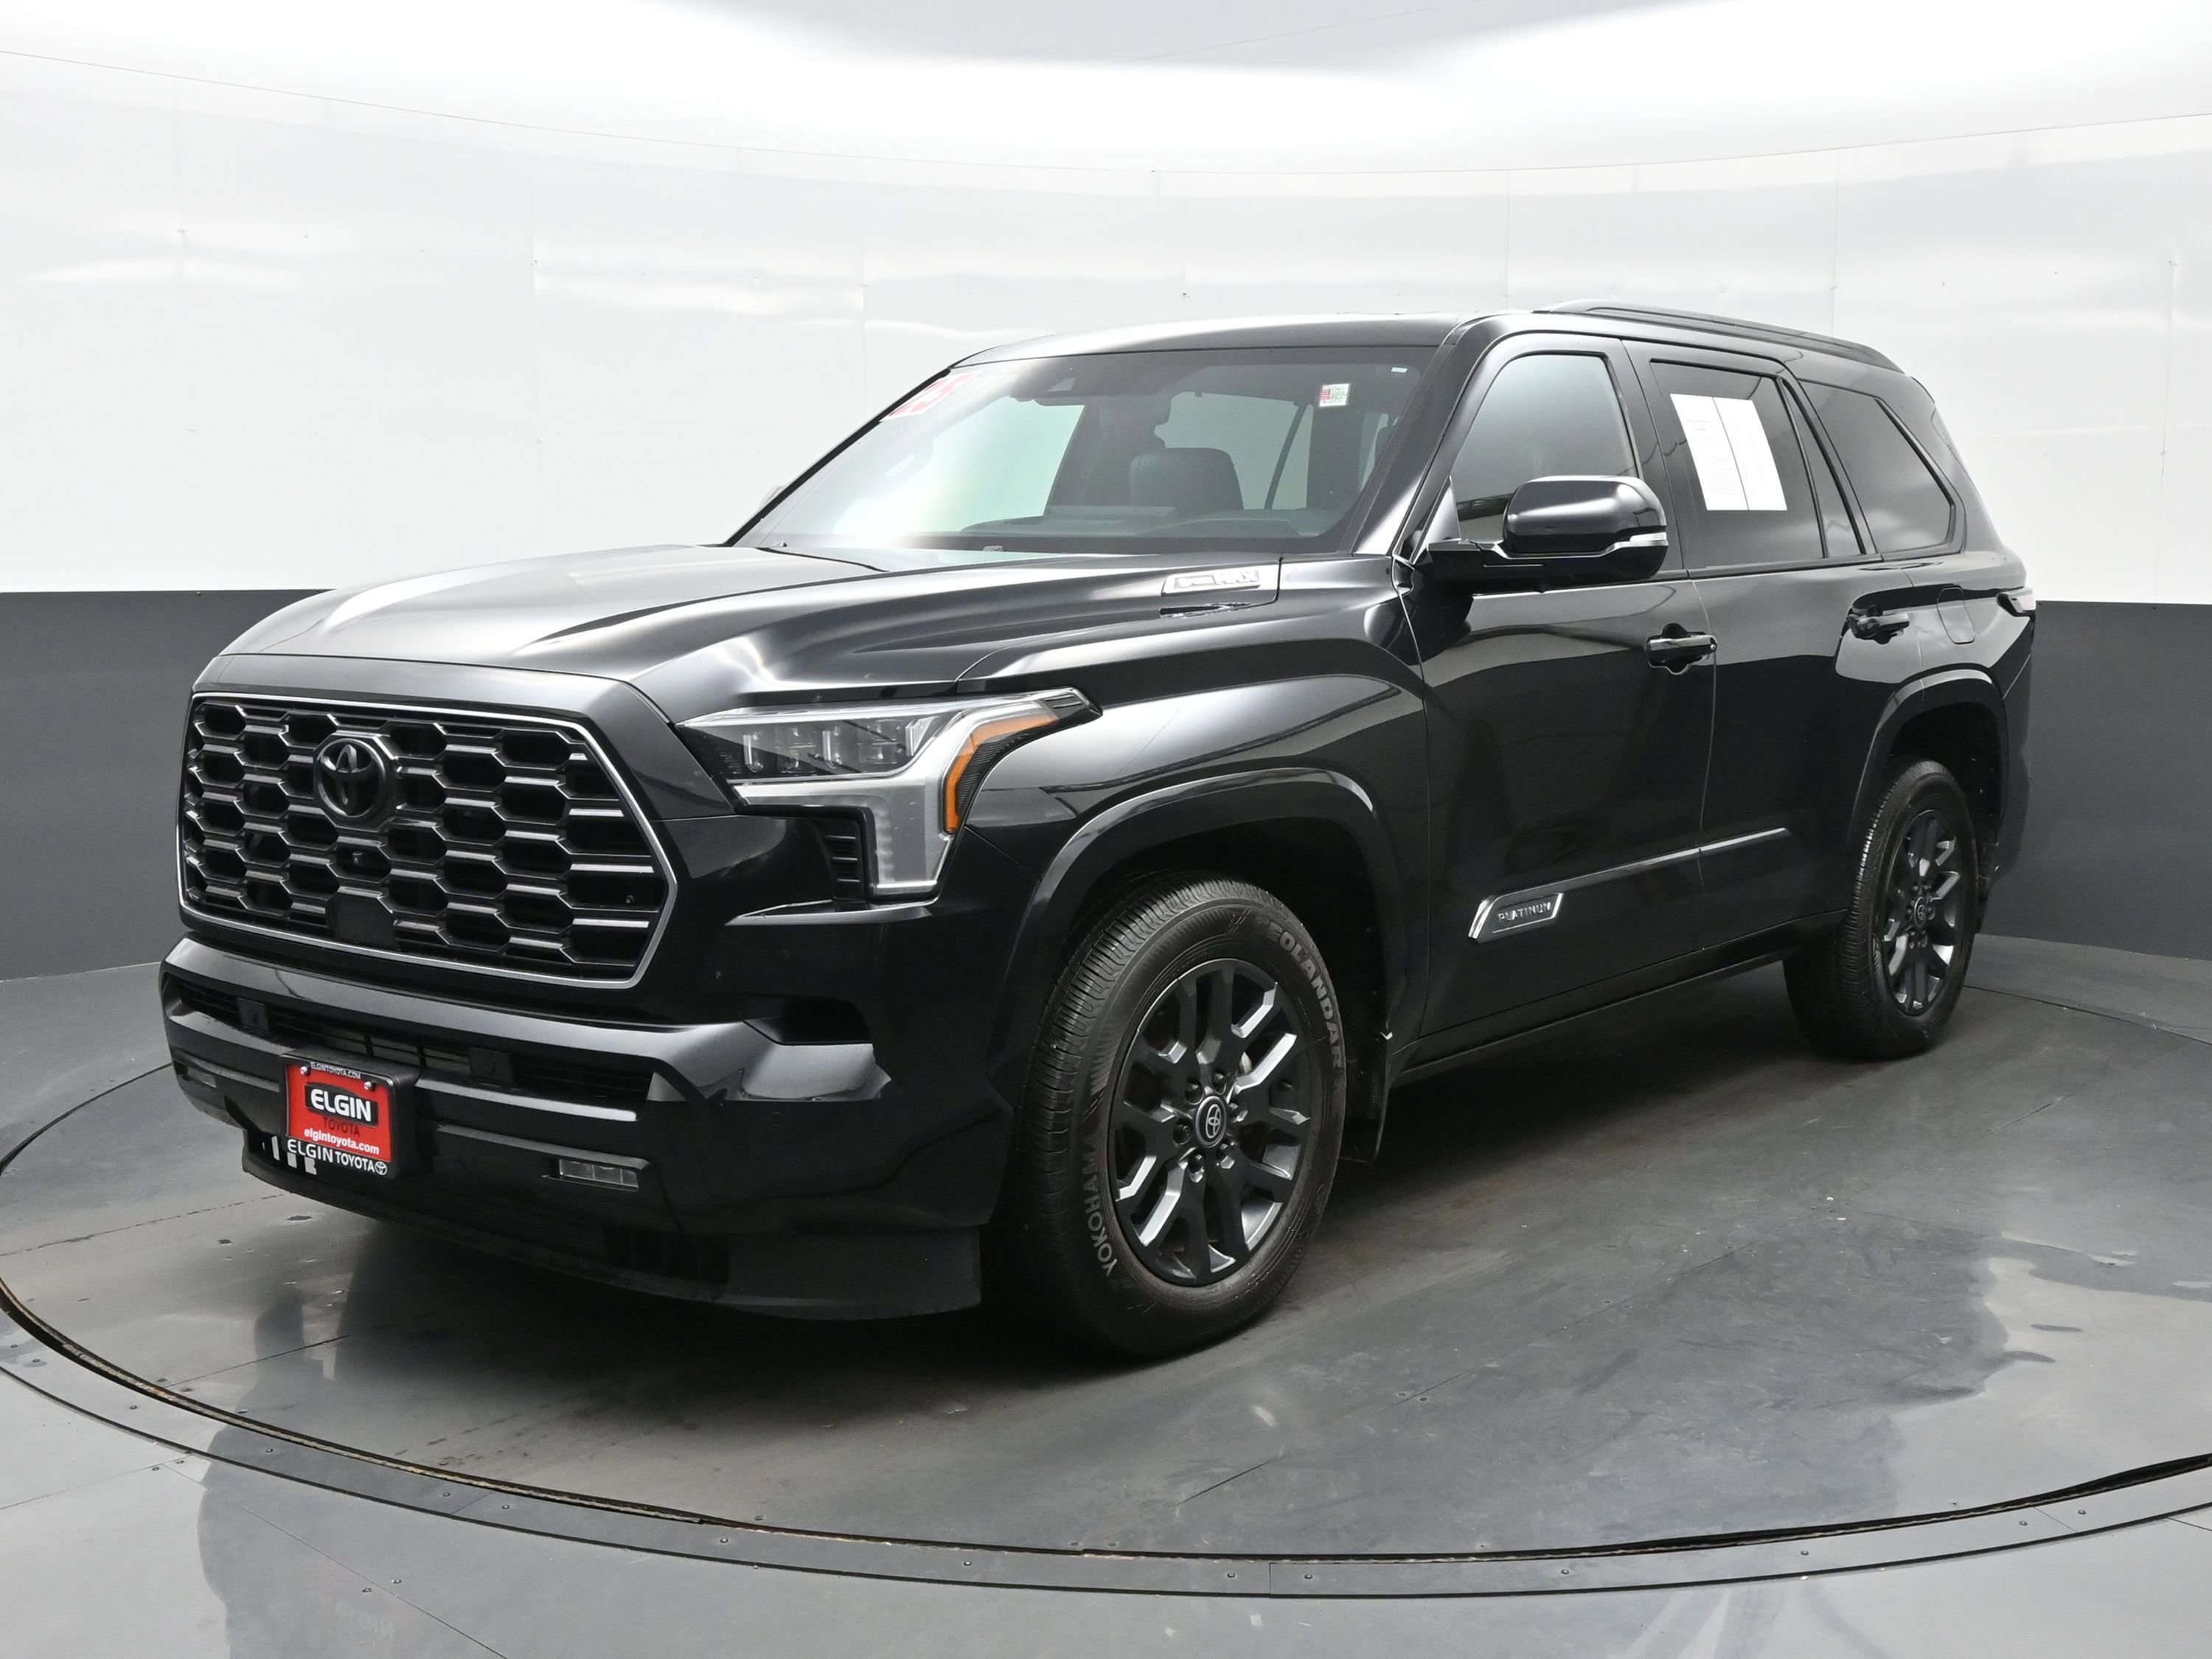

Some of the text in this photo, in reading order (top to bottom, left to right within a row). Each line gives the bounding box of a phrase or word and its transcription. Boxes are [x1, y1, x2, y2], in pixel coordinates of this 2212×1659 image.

[1498, 902, 1551, 922] PLATINUM
[1256, 916, 1343, 1068] EOLANDAR
[310, 1062, 361, 1079] ELGINTOYOTA.COM
[310, 1088, 372, 1122] ELGIN
[323, 1116, 361, 1138] TOYOTA
[304, 1128, 380, 1155] elgintoyota.com
[287, 1138, 375, 1173] ELGIN TOYOTA
